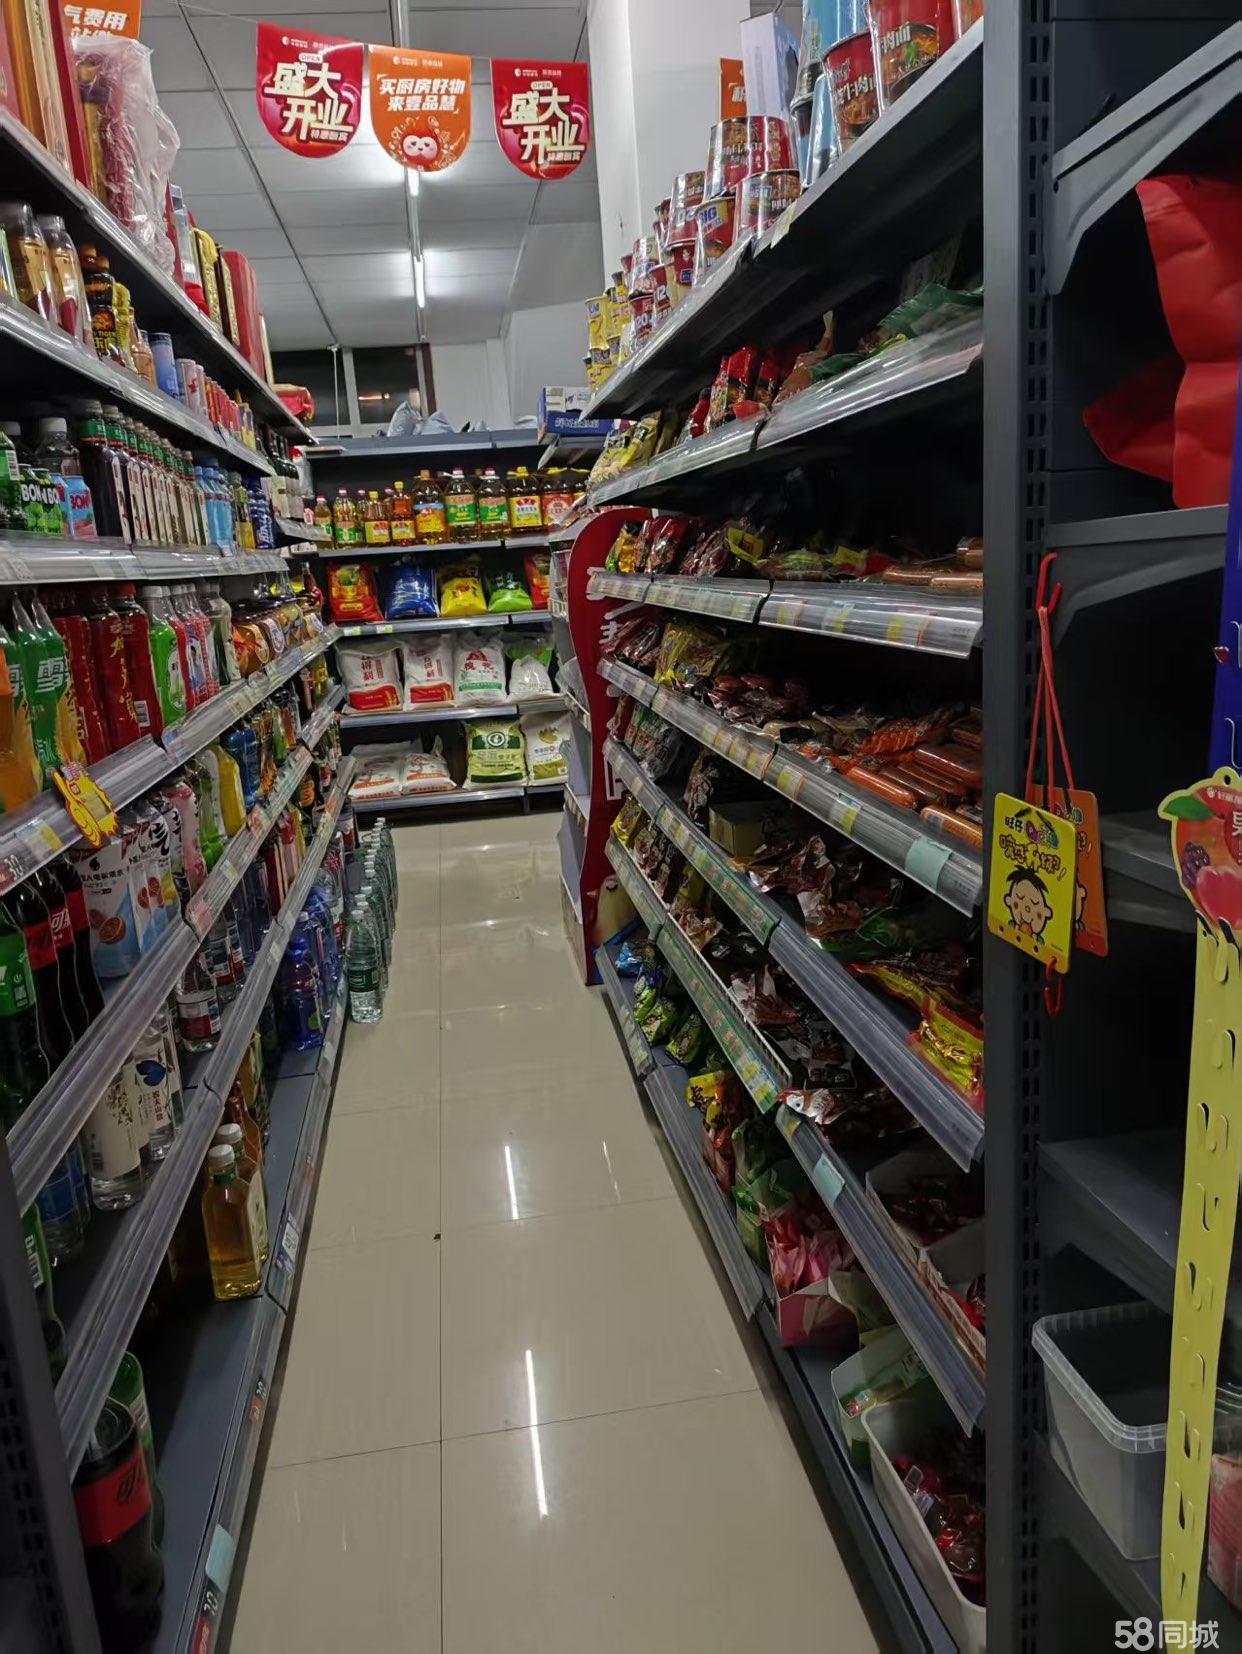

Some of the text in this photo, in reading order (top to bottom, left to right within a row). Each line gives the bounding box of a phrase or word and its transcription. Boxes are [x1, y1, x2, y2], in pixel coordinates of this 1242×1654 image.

[263, 61, 341, 98] 盛大
[379, 77, 466, 95] 买厨房好物
[281, 97, 354, 141] 开业
[387, 94, 457, 112] 来壹品慧
[502, 86, 570, 126] 盛大
[520, 119, 585, 164] 开业
